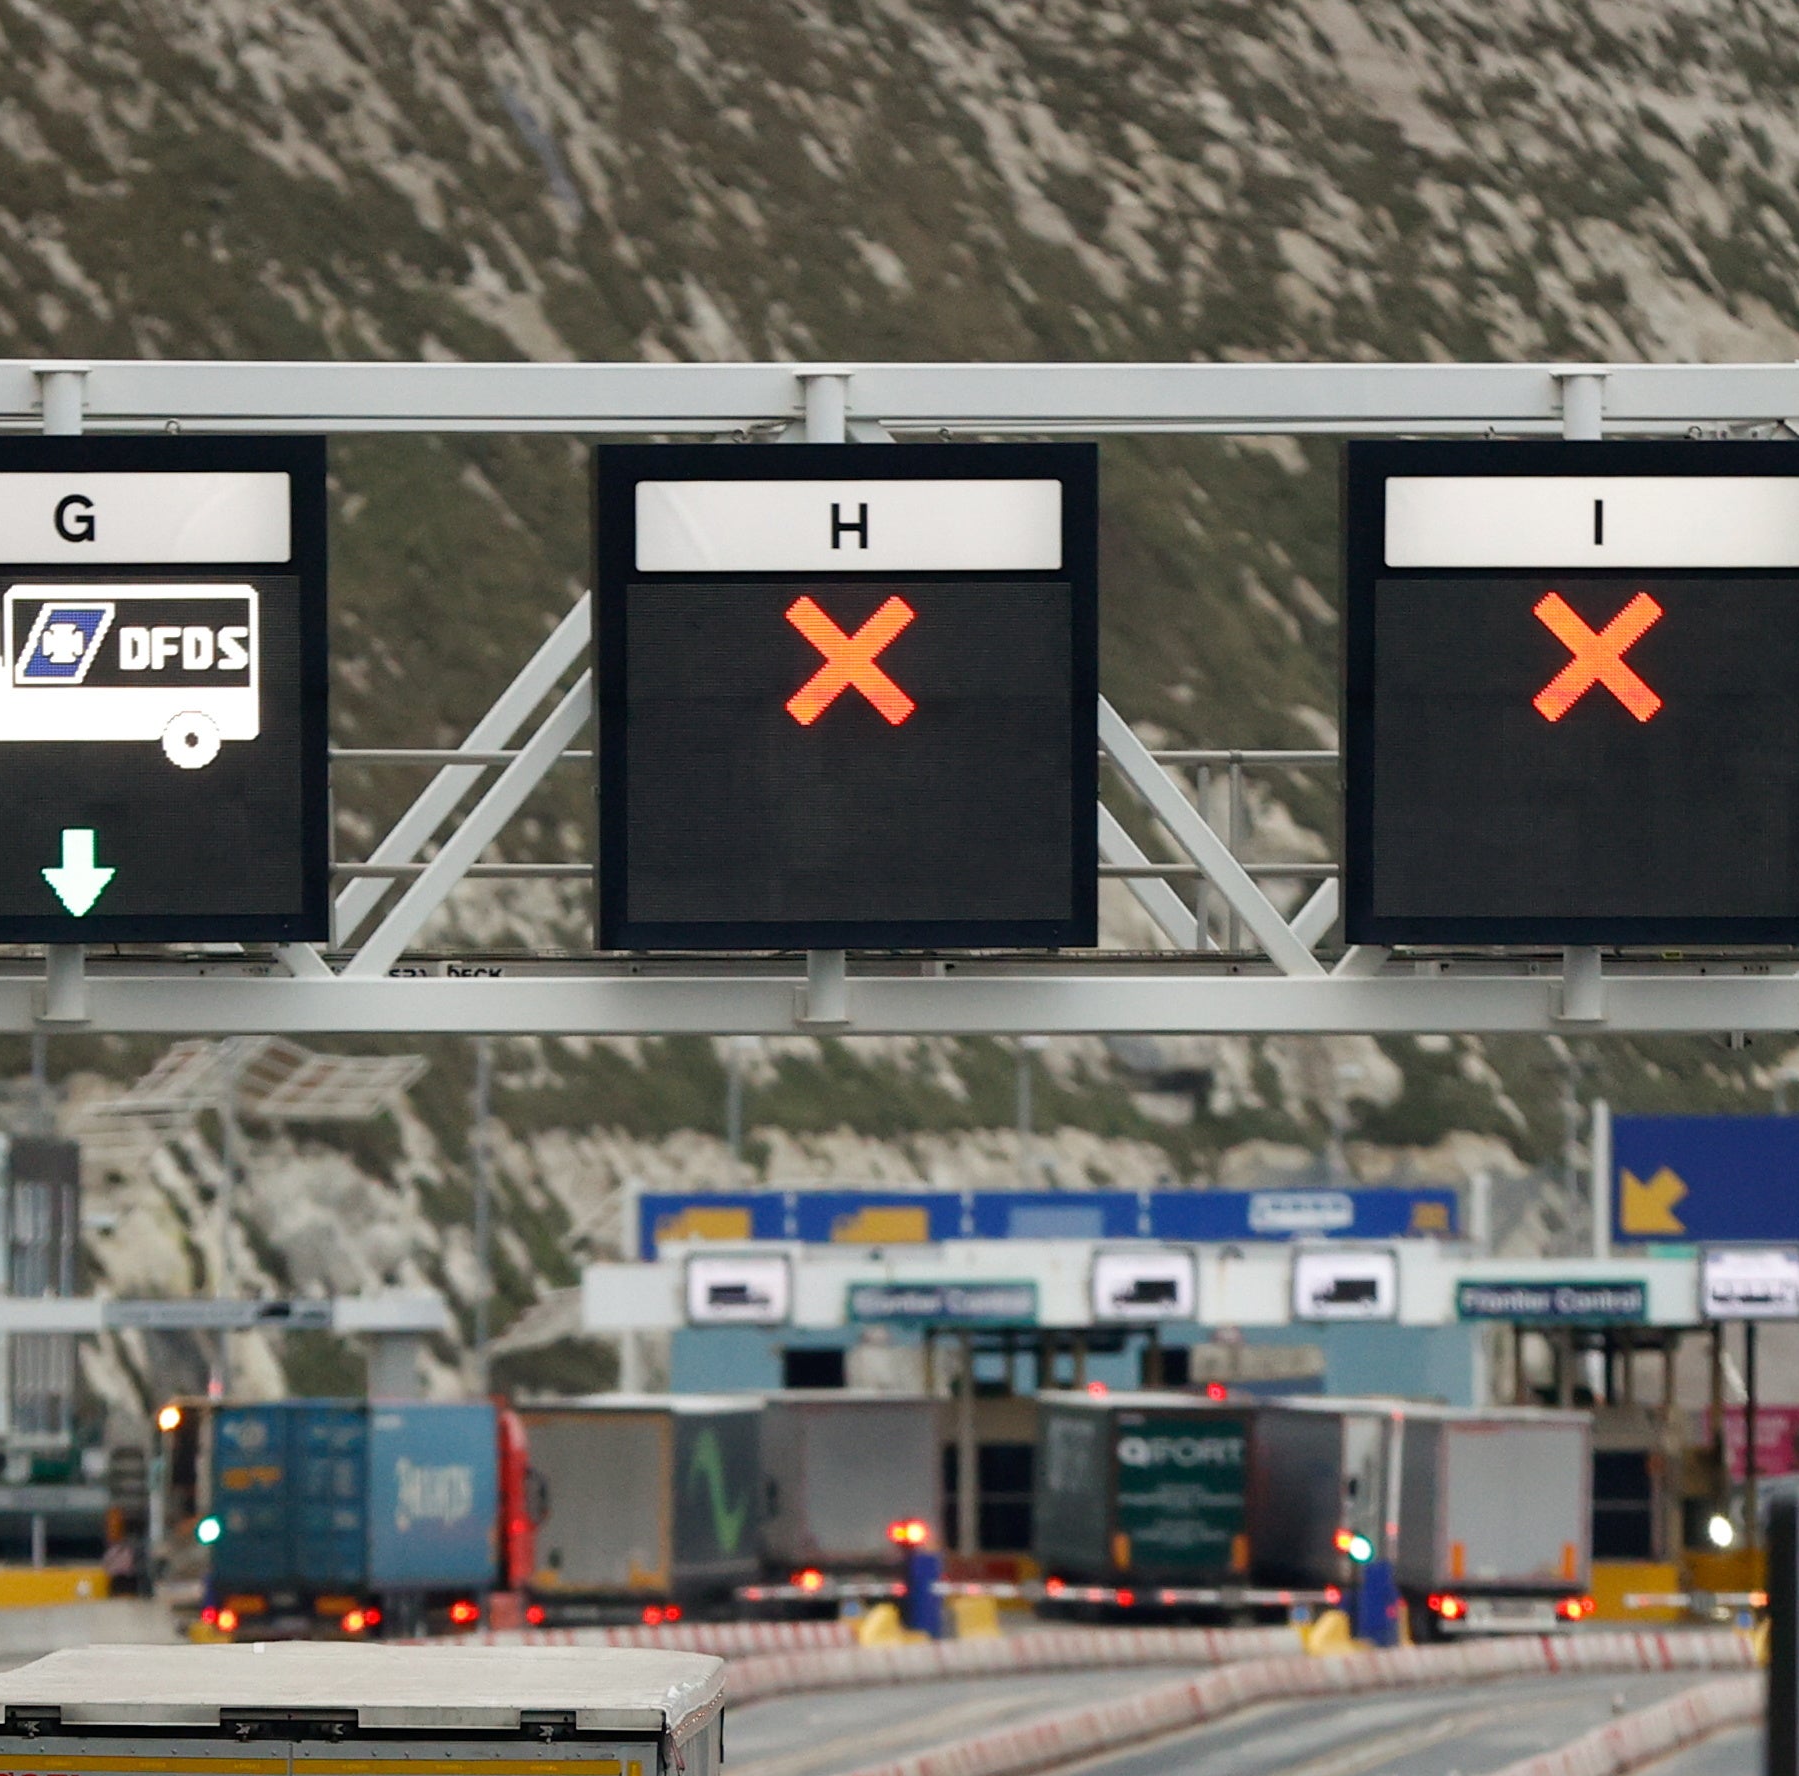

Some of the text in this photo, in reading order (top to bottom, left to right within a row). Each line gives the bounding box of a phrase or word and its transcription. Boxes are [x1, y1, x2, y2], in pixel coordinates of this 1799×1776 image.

[53, 493, 96, 543] G
[830, 501, 869, 551] H
[1593, 499, 1605, 547] I
[118, 625, 249, 671] DFDS
